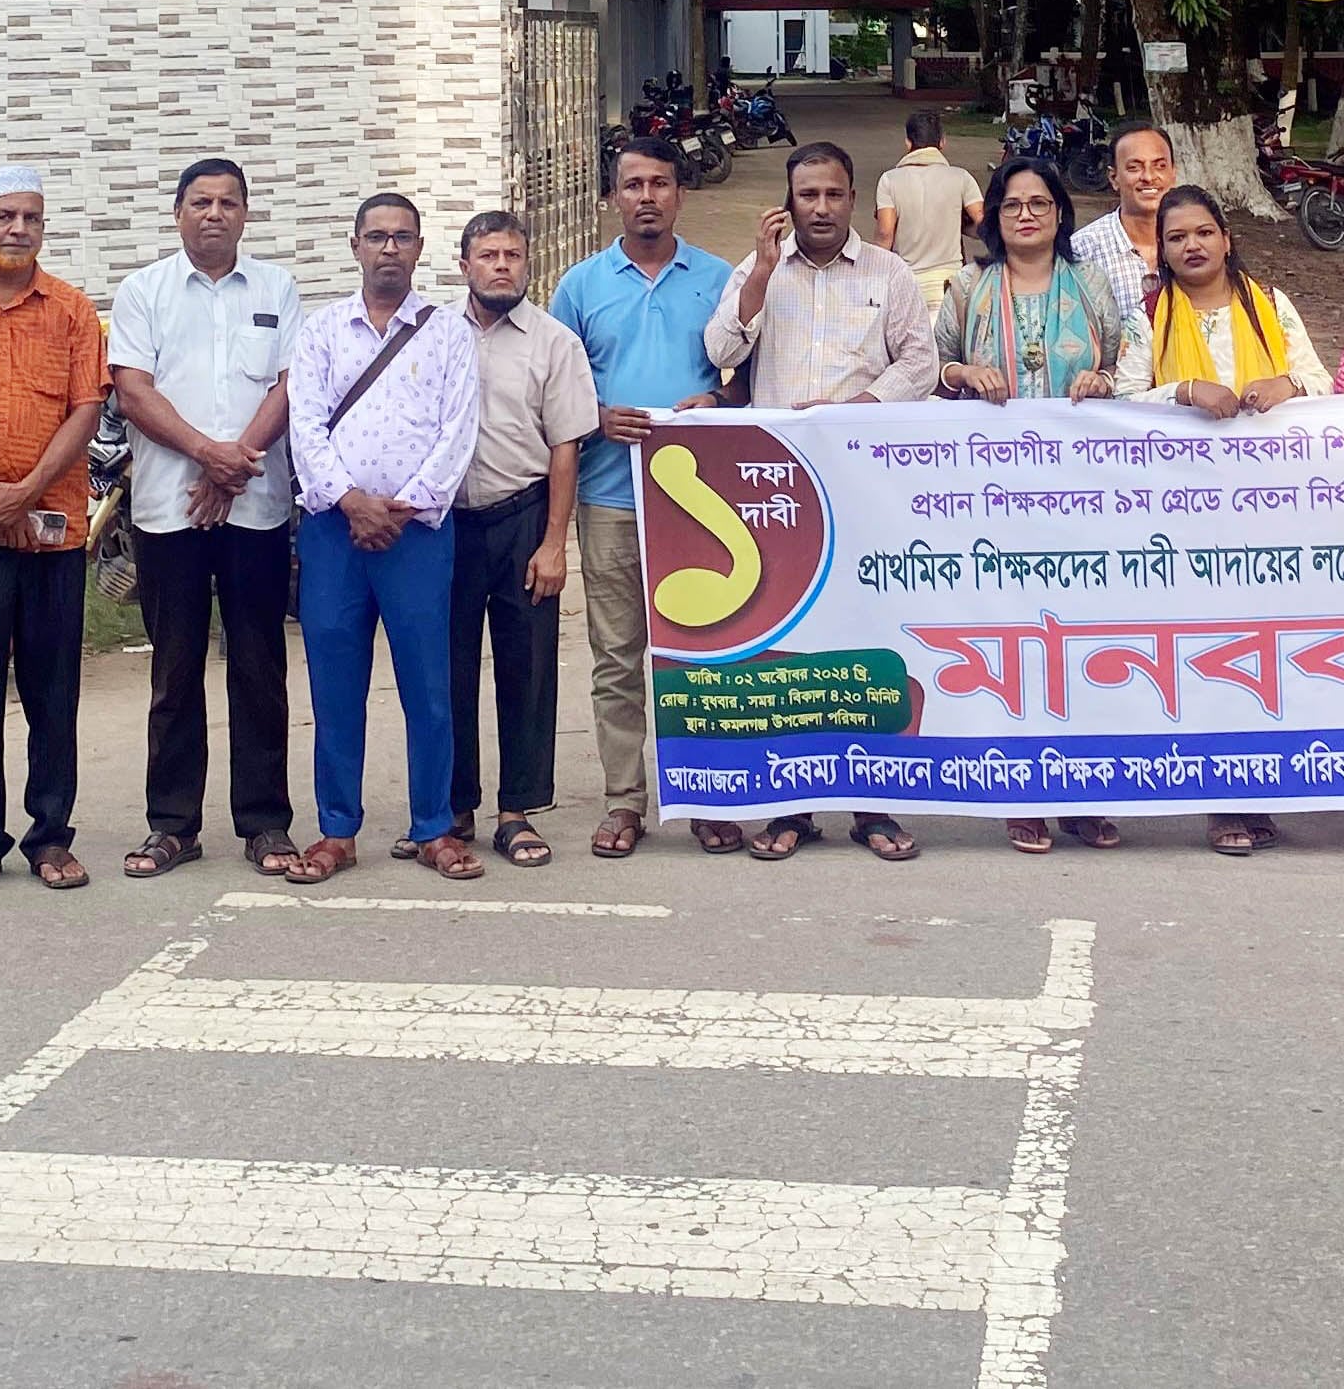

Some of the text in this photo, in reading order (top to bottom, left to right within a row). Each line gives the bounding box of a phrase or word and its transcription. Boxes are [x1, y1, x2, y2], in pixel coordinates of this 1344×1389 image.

[966, 430, 1063, 468] বিভাগীয়
[1072, 429, 1215, 469] পদোন্নতিসহ
[1222, 426, 1314, 465] সহকারী
[735, 460, 799, 489] দফা
[736, 493, 802, 529] দাবী
[911, 490, 974, 519] প্রধান
[981, 482, 1105, 518] শিক্ষকদের
[1114, 488, 1153, 515] ৯ম
[1161, 486, 1222, 516] গ্রেডে
[1232, 484, 1299, 515] বেতন
[649, 444, 762, 627] ১
[857, 539, 964, 594] প্রাথমিক
[969, 537, 1109, 591] শিক্ষকদের
[1116, 532, 1178, 590] দাবী
[1185, 541, 1303, 588] আদায়ের
[734, 672, 754, 687] ০২
[757, 666, 808, 685] অক্টোবর
[813, 667, 849, 683] ২০২৪
[788, 687, 826, 706] বিকাল
[830, 690, 862, 704] ৪.২০
[719, 717, 768, 733] কমলগঞ্জ
[772, 711, 823, 730] উপজেলা
[665, 765, 749, 794] আয়োজনে
[766, 747, 840, 790] বৈষম্য
[844, 743, 934, 789] নিরসনে
[939, 747, 1032, 794] প্রাথমিক
[1038, 746, 1116, 792] শিক্ষক
[1122, 744, 1206, 791] সংগঠন
[1209, 748, 1282, 787] সমন্বয়
